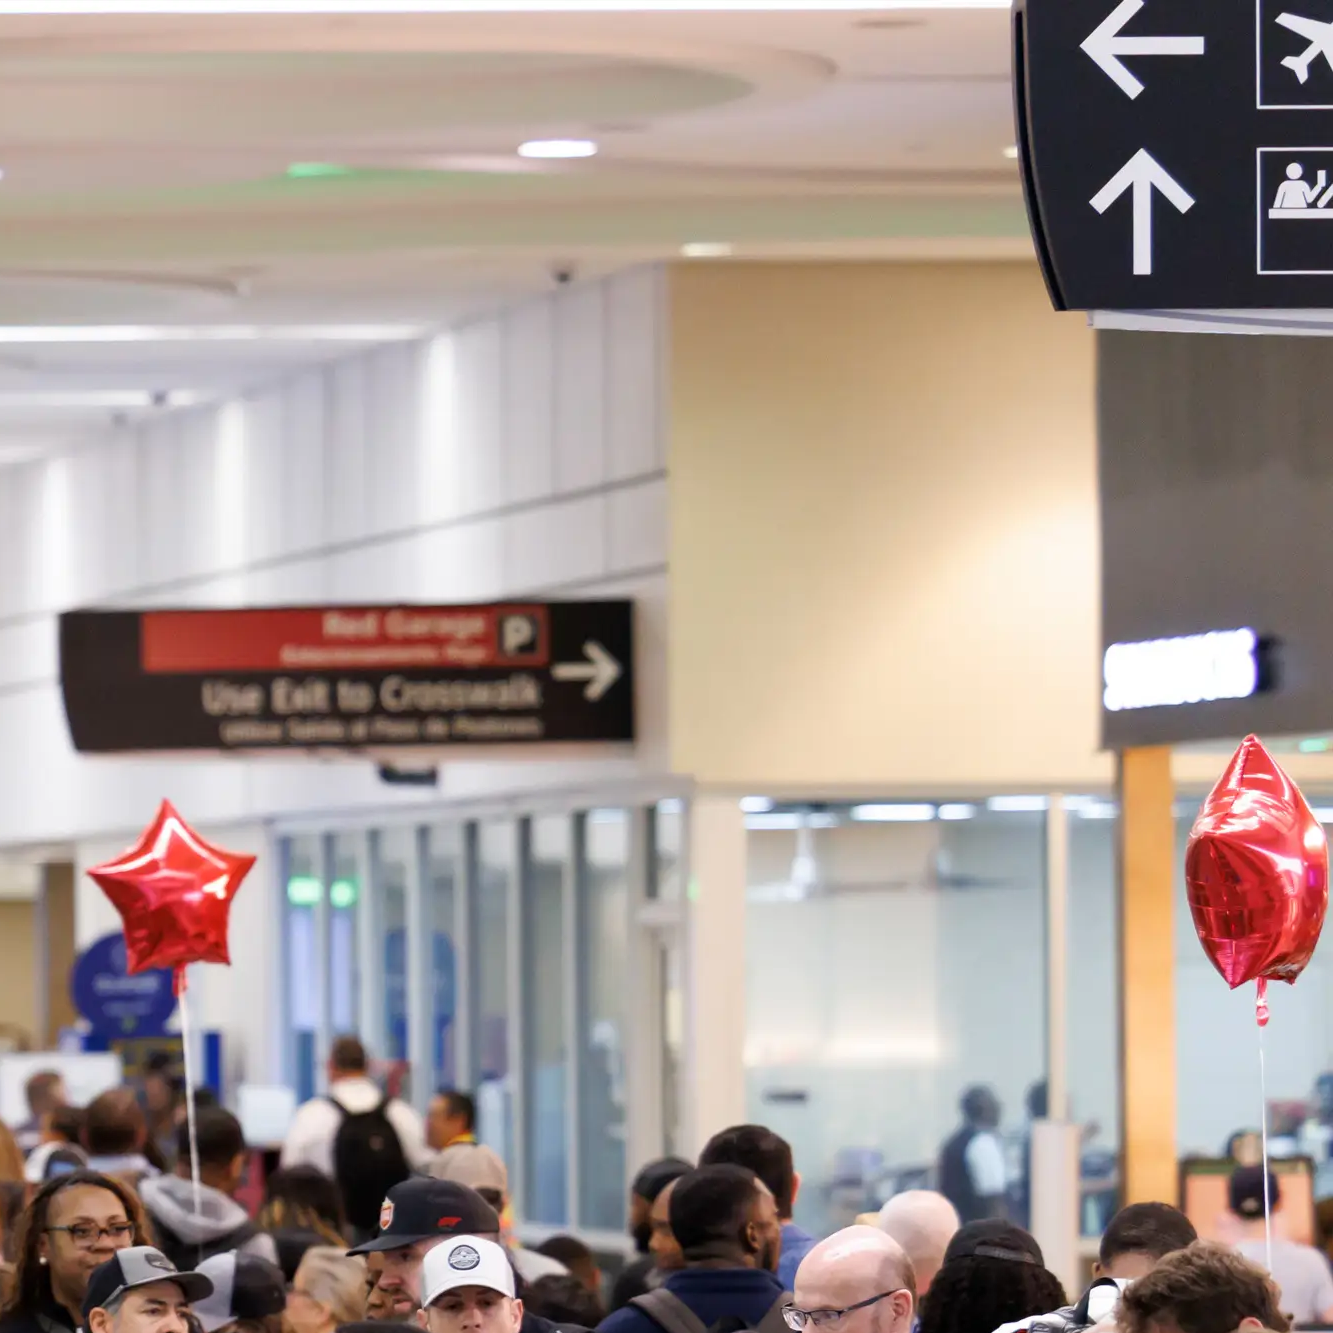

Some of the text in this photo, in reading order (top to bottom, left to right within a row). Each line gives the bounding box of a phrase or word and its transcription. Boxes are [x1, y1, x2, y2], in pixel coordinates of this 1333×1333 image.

[201, 674, 540, 714] Use Exit to Crosswalk
